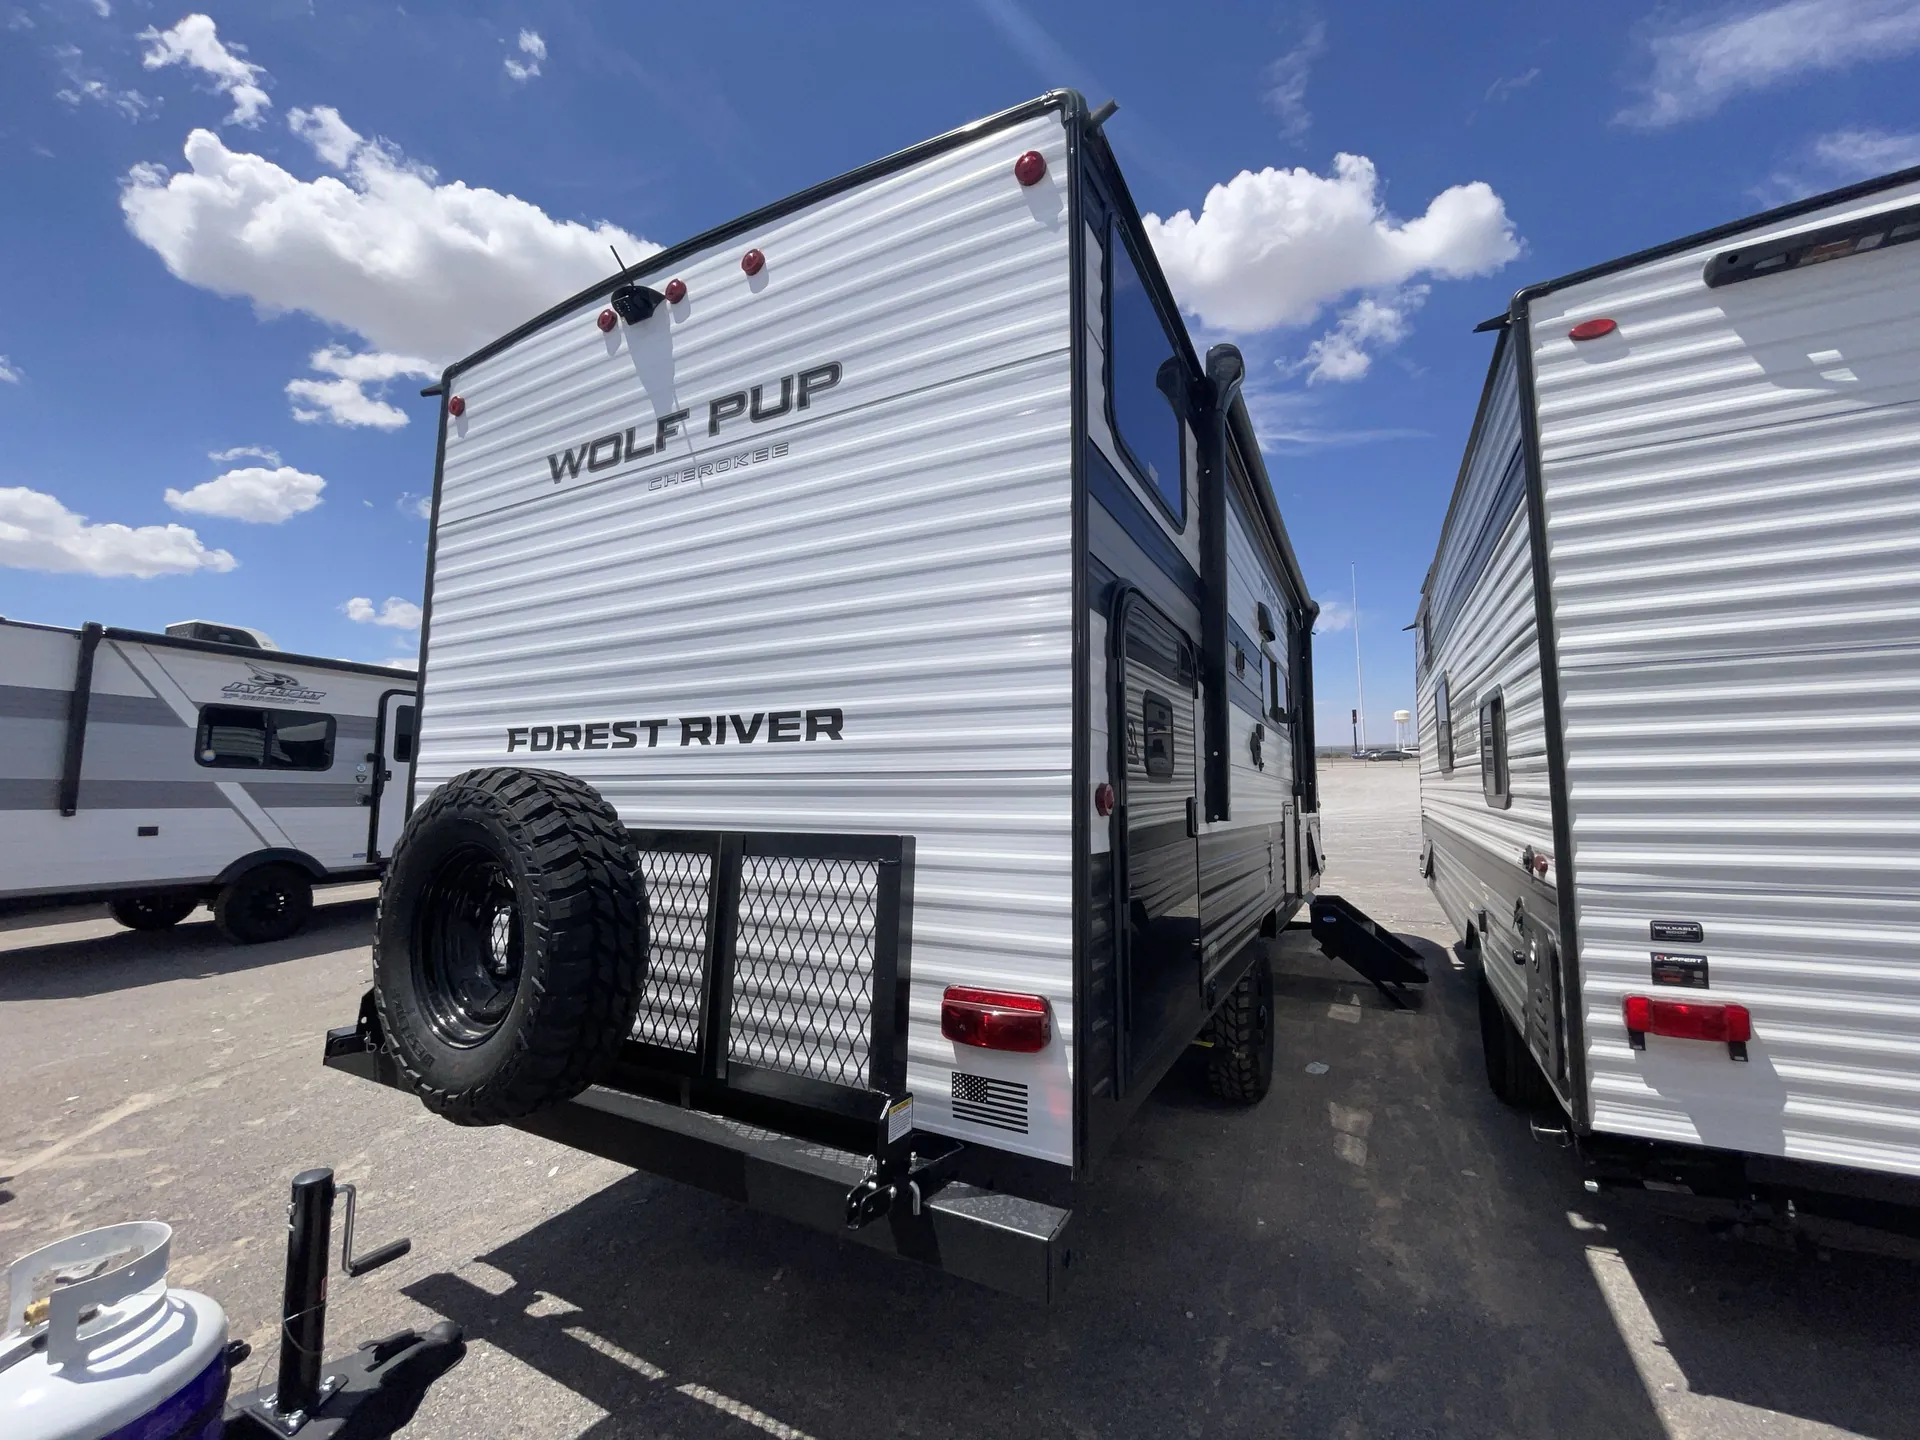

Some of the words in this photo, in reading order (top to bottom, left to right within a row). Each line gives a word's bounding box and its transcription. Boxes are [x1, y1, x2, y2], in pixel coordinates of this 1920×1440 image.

[547, 408, 690, 484] WOLF
[708, 361, 843, 437] PUP
[648, 442, 789, 491] CHEROKEE
[221, 682, 263, 694] JAY
[260, 686, 327, 700] FLIGHT
[507, 719, 668, 753] FOREST
[678, 708, 844, 746] RIVER
